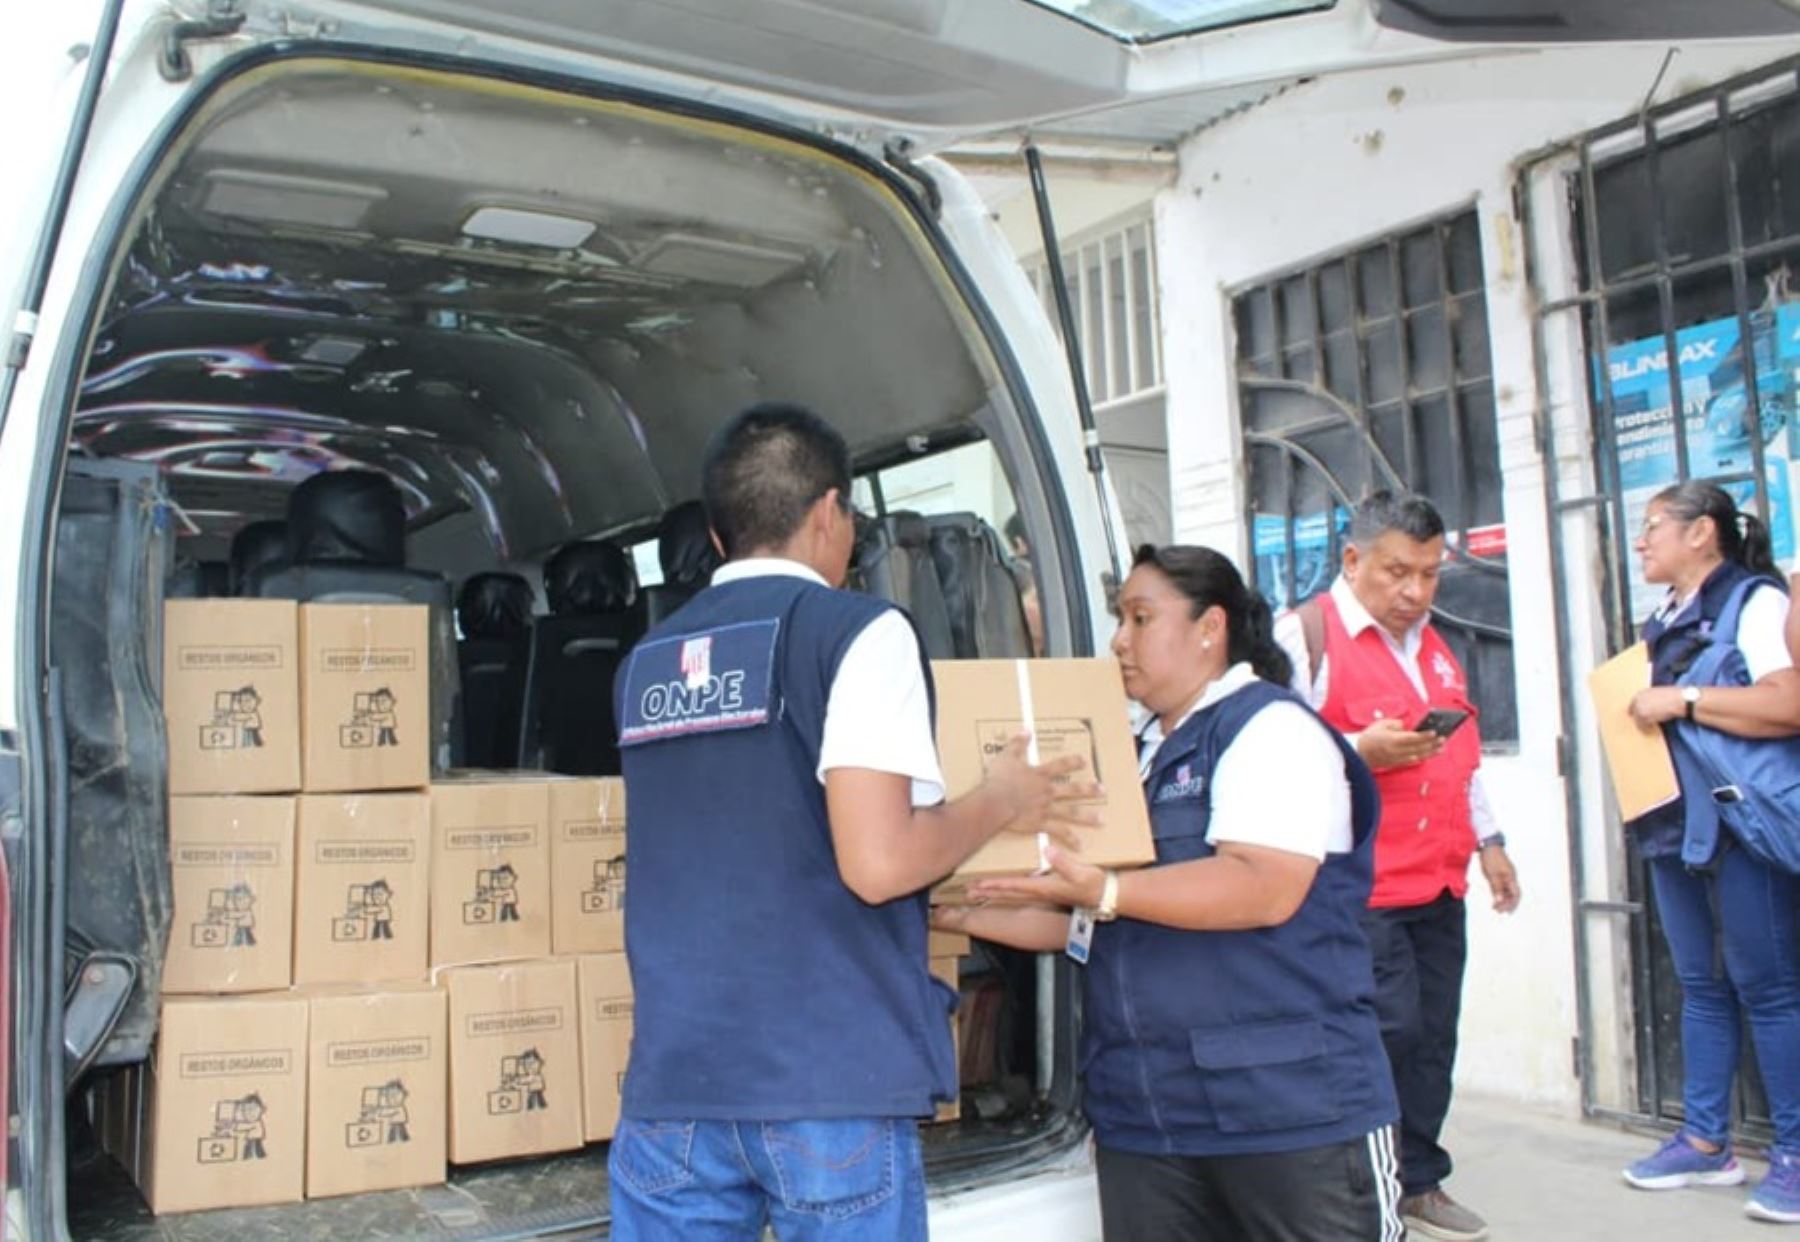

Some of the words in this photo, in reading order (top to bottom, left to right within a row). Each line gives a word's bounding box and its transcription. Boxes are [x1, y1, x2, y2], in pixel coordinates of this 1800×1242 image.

[641, 670, 745, 721] ONPE
[472, 1020, 506, 1032] RESTOS
[333, 1049, 369, 1061] RESTOS
[188, 1060, 226, 1073] RESTOS
